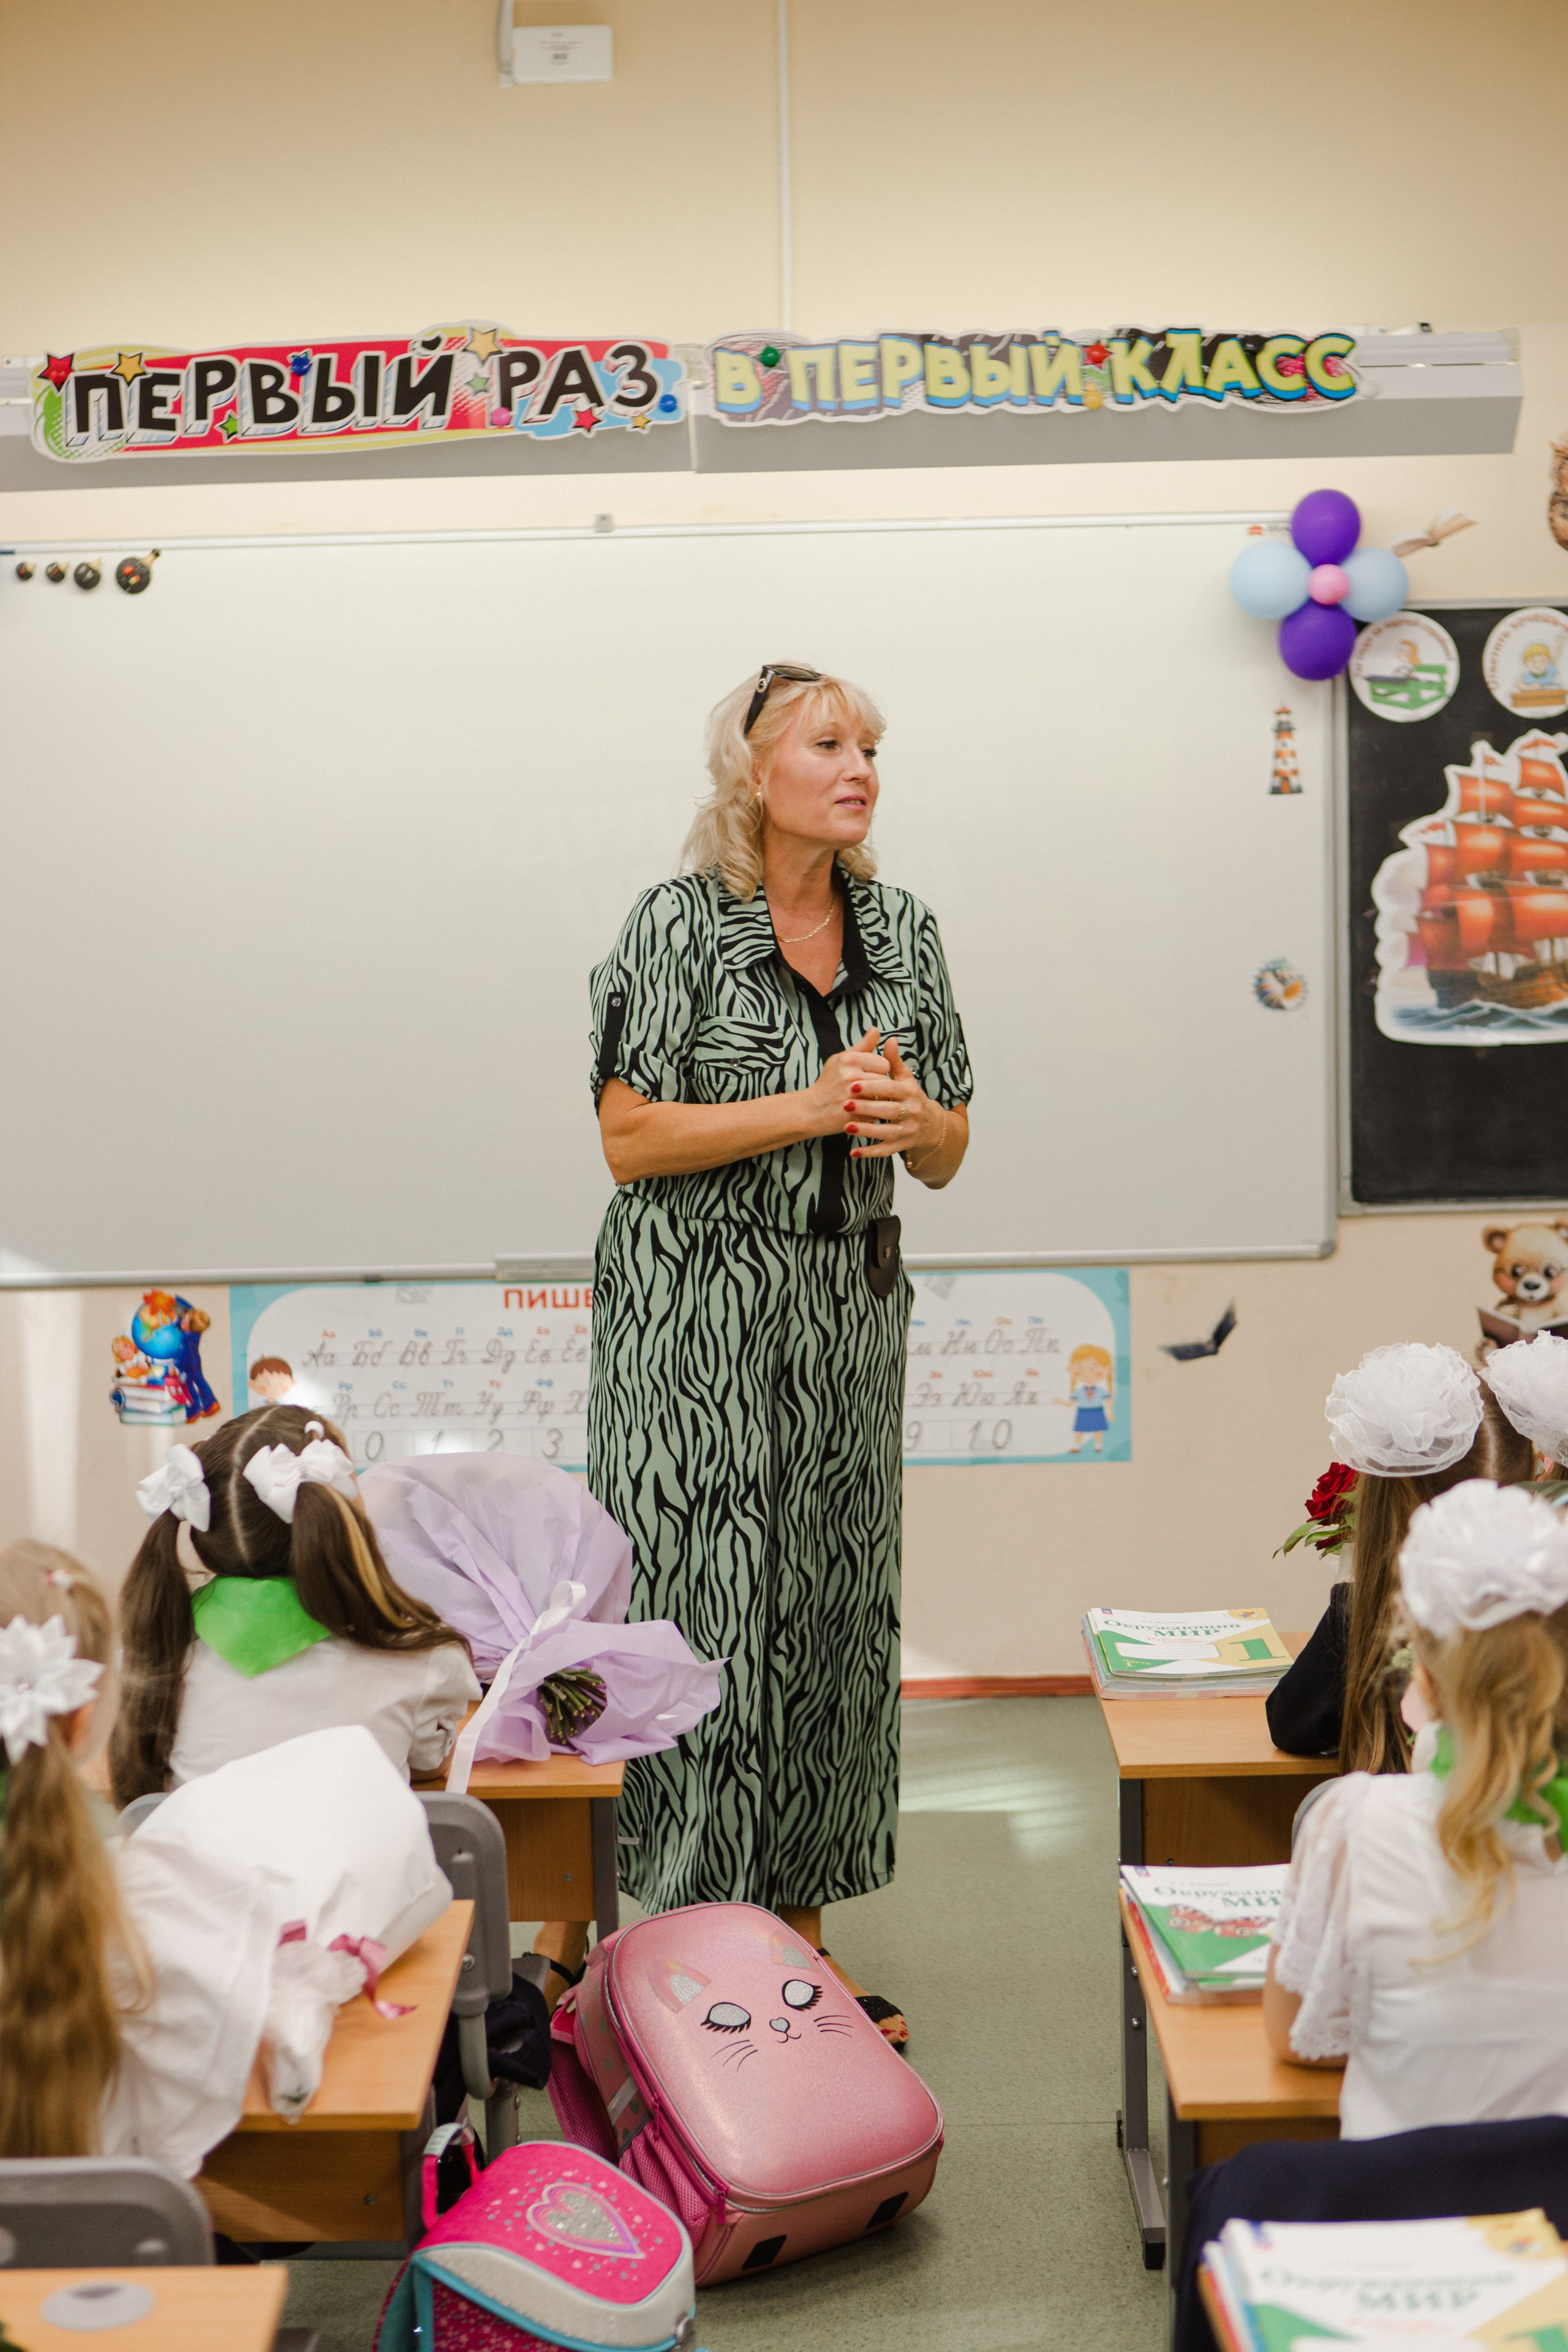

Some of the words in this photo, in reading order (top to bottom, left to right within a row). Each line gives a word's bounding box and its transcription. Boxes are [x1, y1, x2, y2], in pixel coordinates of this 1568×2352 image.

[715, 347, 763, 413] В
[786, 331, 1084, 411] ПЕРВЫЙ
[1109, 328, 1356, 402] КЛАСС
[66, 335, 454, 447] ПЕРВЫЙ
[492, 344, 657, 425] РАЗ
[365, 1431, 384, 1460] 0
[488, 1428, 504, 1452] 2
[543, 1428, 563, 1458] 3
[1104, 1619, 1241, 1630] Окружающий
[1227, 1638, 1286, 1661] 1
